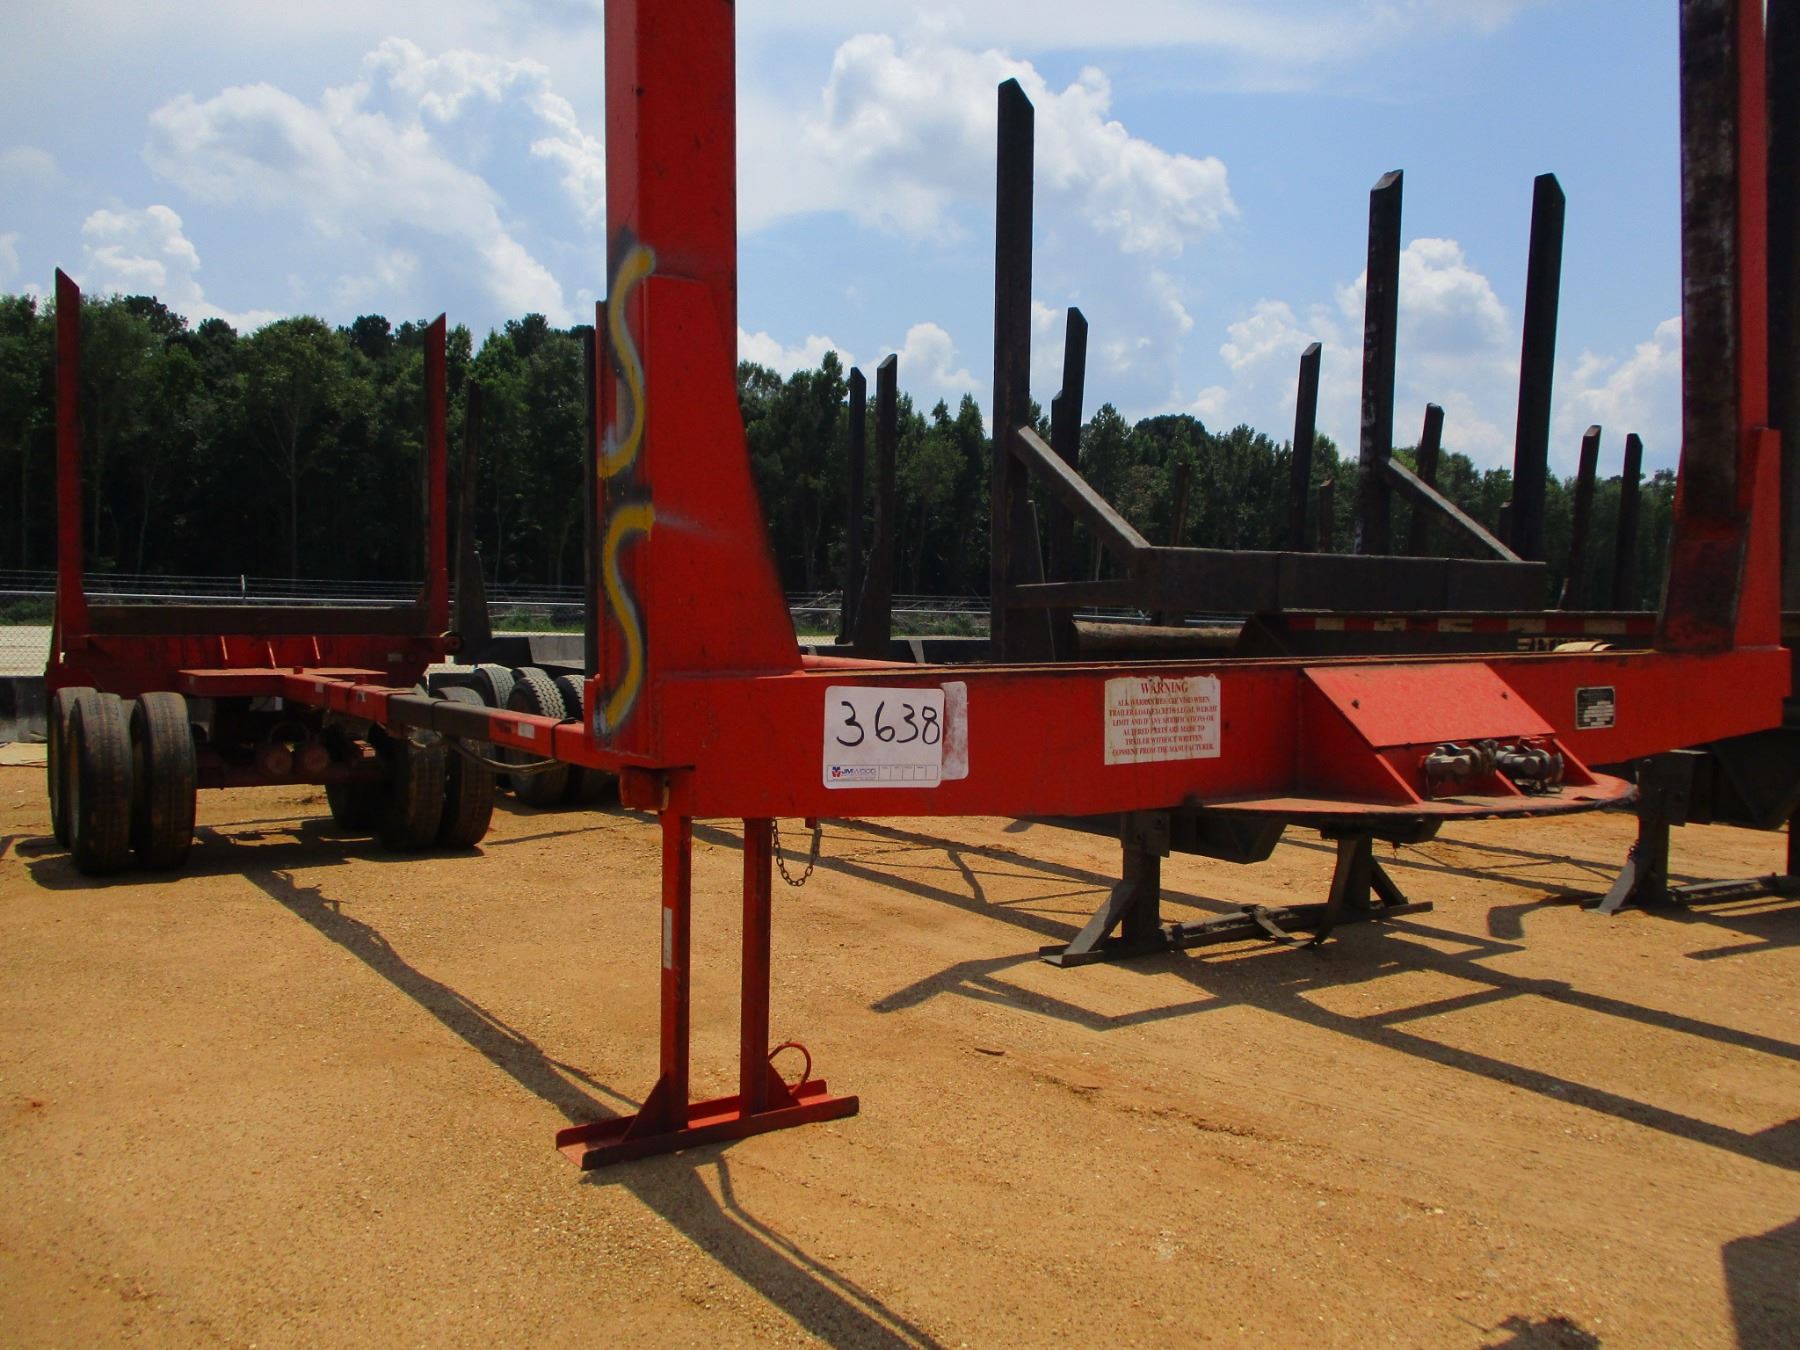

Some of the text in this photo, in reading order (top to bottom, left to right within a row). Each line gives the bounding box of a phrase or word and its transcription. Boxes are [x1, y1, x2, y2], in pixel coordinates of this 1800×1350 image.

[1141, 681, 1188, 694] WARNING
[836, 700, 940, 747] 3638
[1151, 736, 1176, 744] WITHOUT
